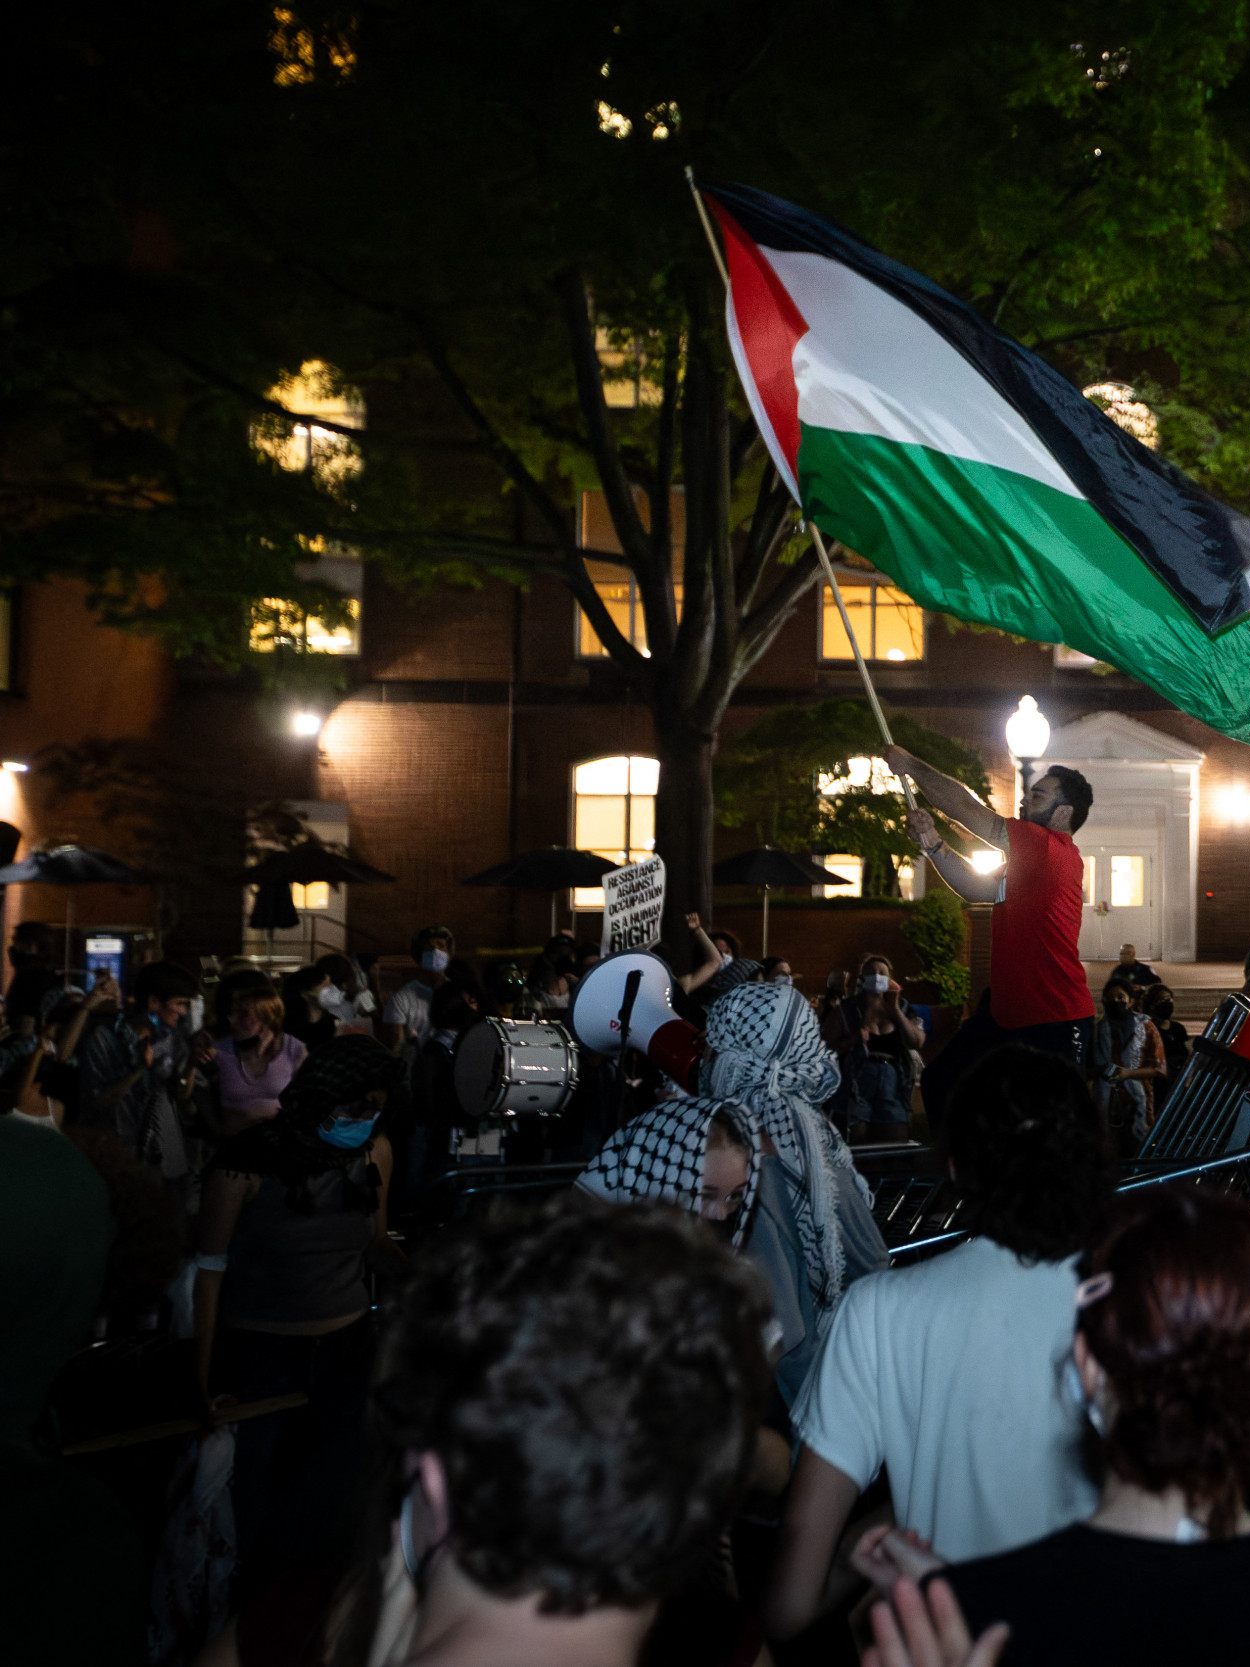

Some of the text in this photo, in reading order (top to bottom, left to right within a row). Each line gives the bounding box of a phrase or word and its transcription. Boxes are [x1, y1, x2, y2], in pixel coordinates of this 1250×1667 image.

[608, 859, 661, 890] RESISTANCE
[616, 875, 654, 899] AGAINST
[608, 884, 663, 917] OCCUPATION
[611, 901, 661, 934] IS A HUMAN
[610, 917, 659, 954] RIGHT
